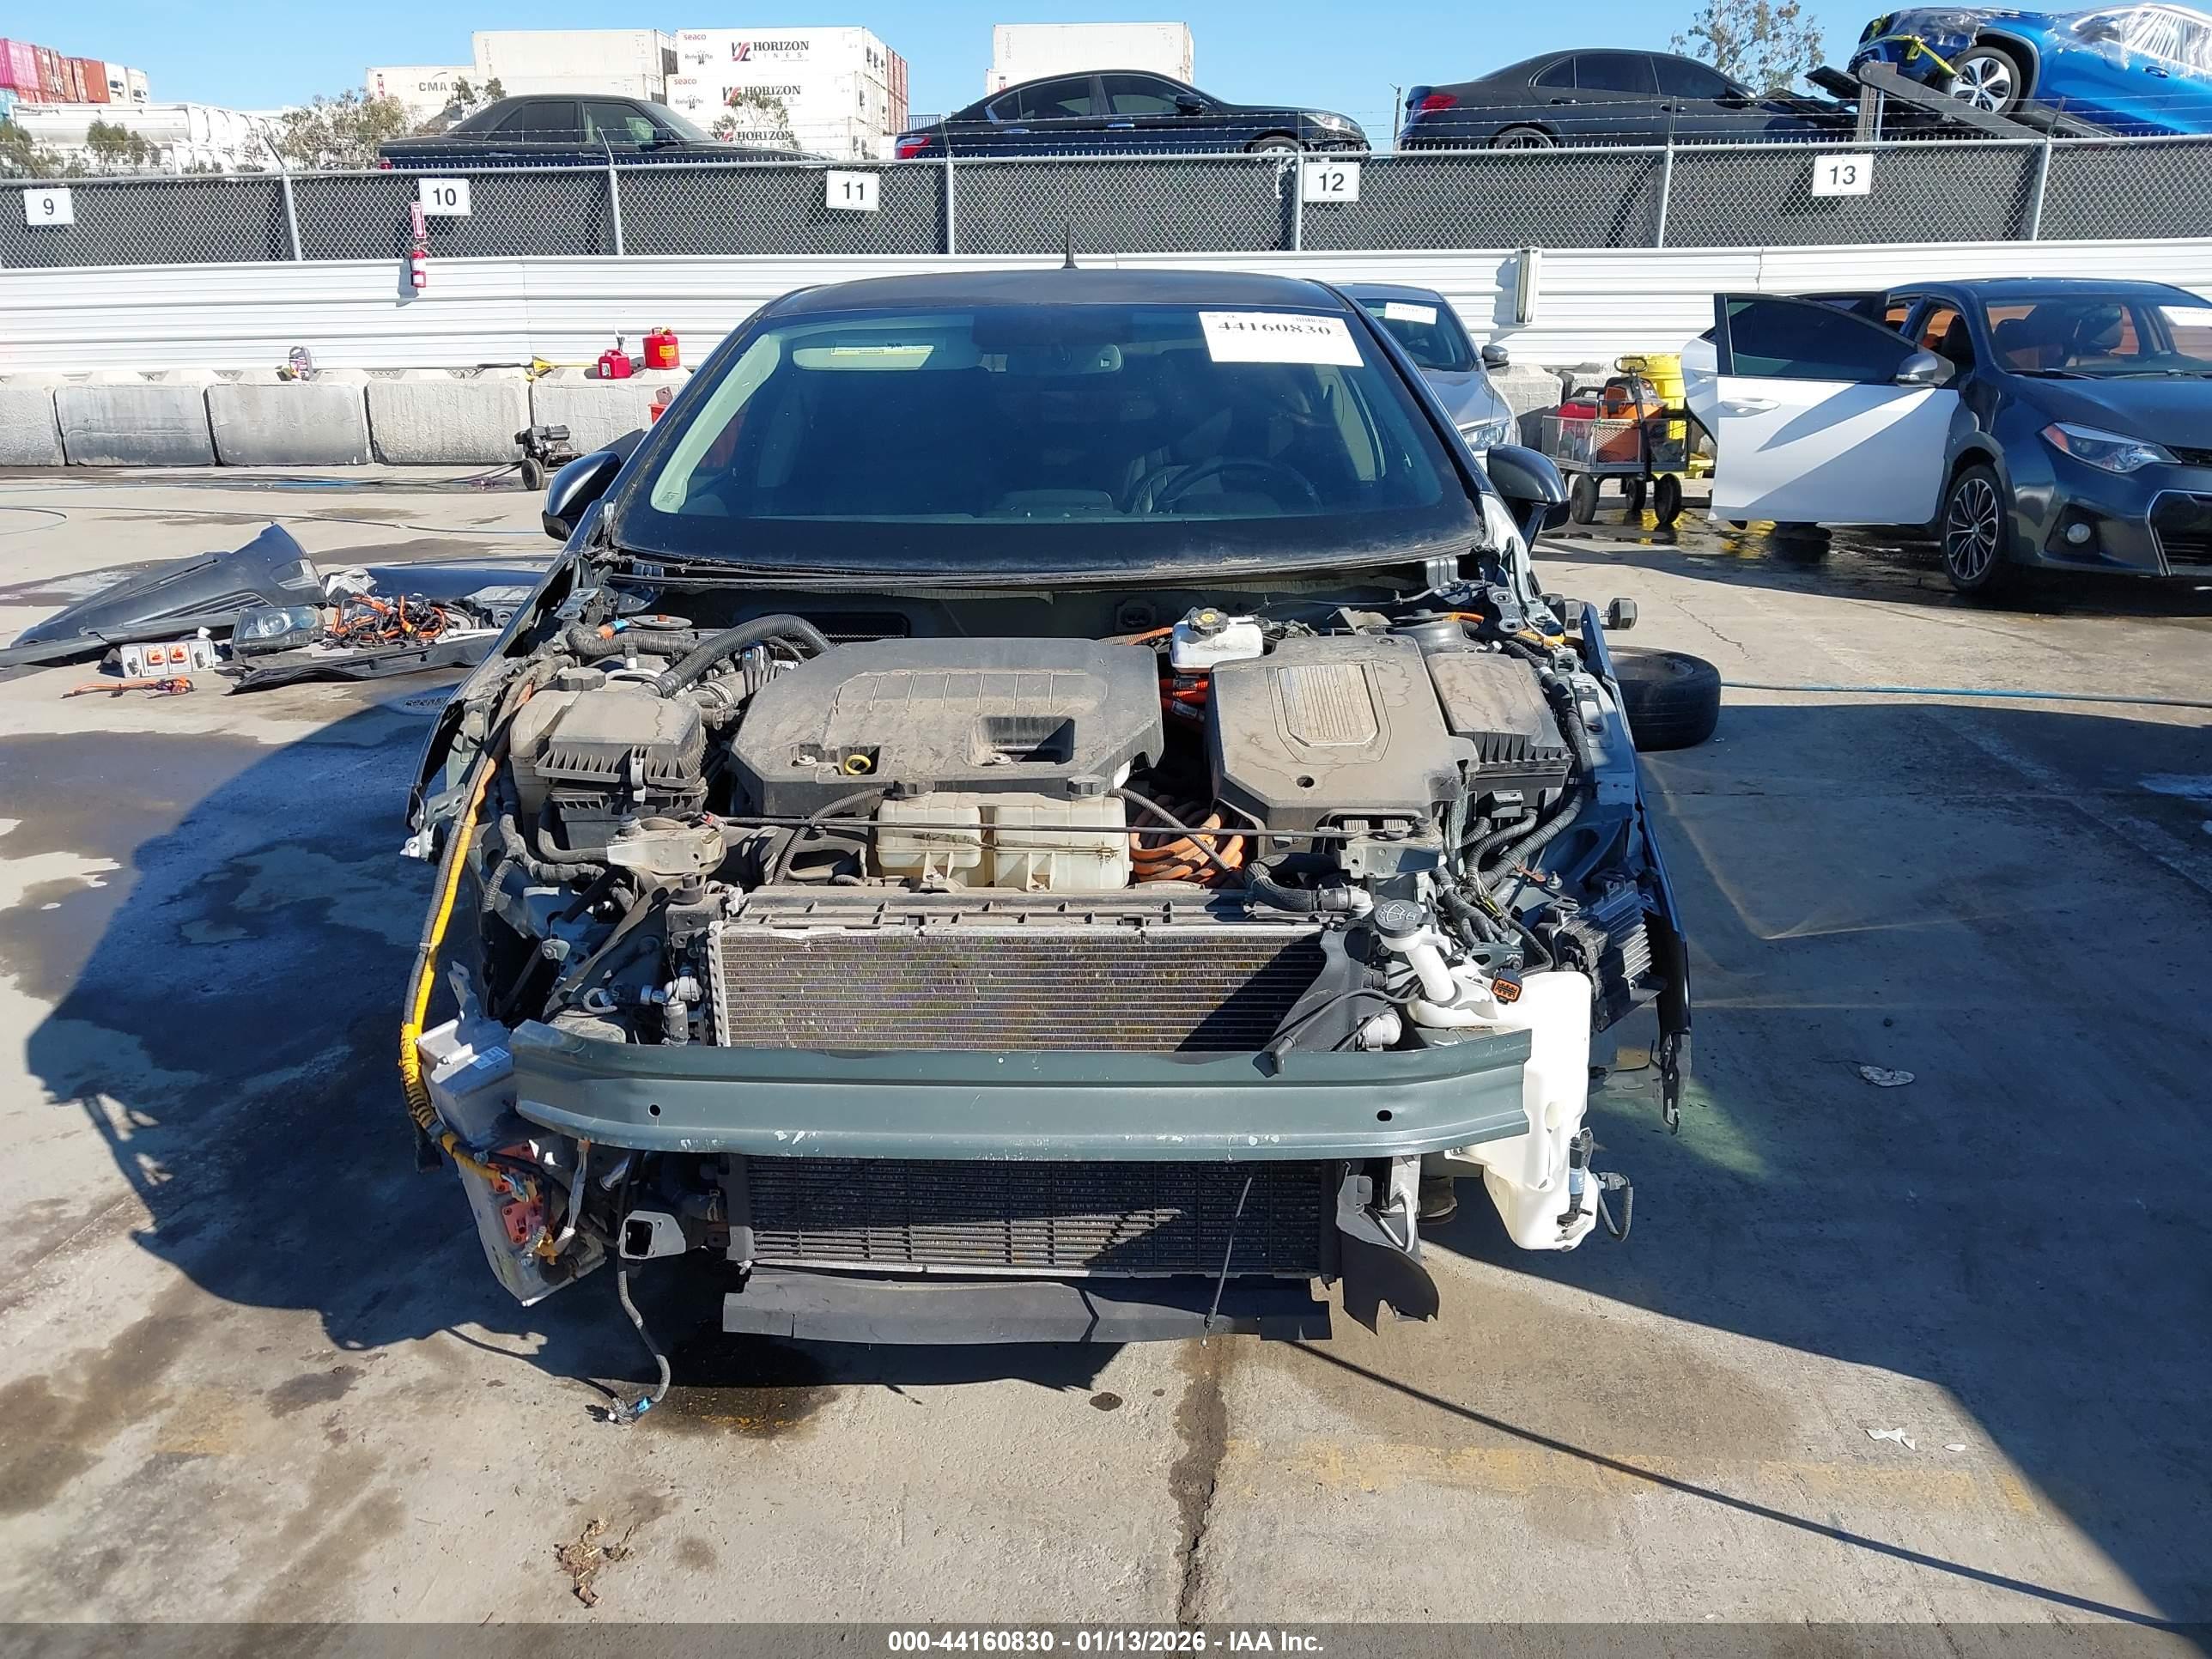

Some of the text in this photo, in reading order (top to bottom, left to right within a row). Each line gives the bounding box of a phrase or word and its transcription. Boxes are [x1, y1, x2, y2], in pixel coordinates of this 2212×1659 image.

[753, 41, 810, 52] HORIZON
[418, 82, 447, 92] CMA
[744, 85, 801, 95] HORIZON
[737, 131, 793, 141] HORIZON
[1318, 173, 1345, 191] 12
[1830, 165, 1856, 185] 13
[433, 187, 457, 206] 10
[842, 181, 865, 201] 11
[43, 198, 55, 216] 9
[1218, 322, 1332, 336] 44160830
